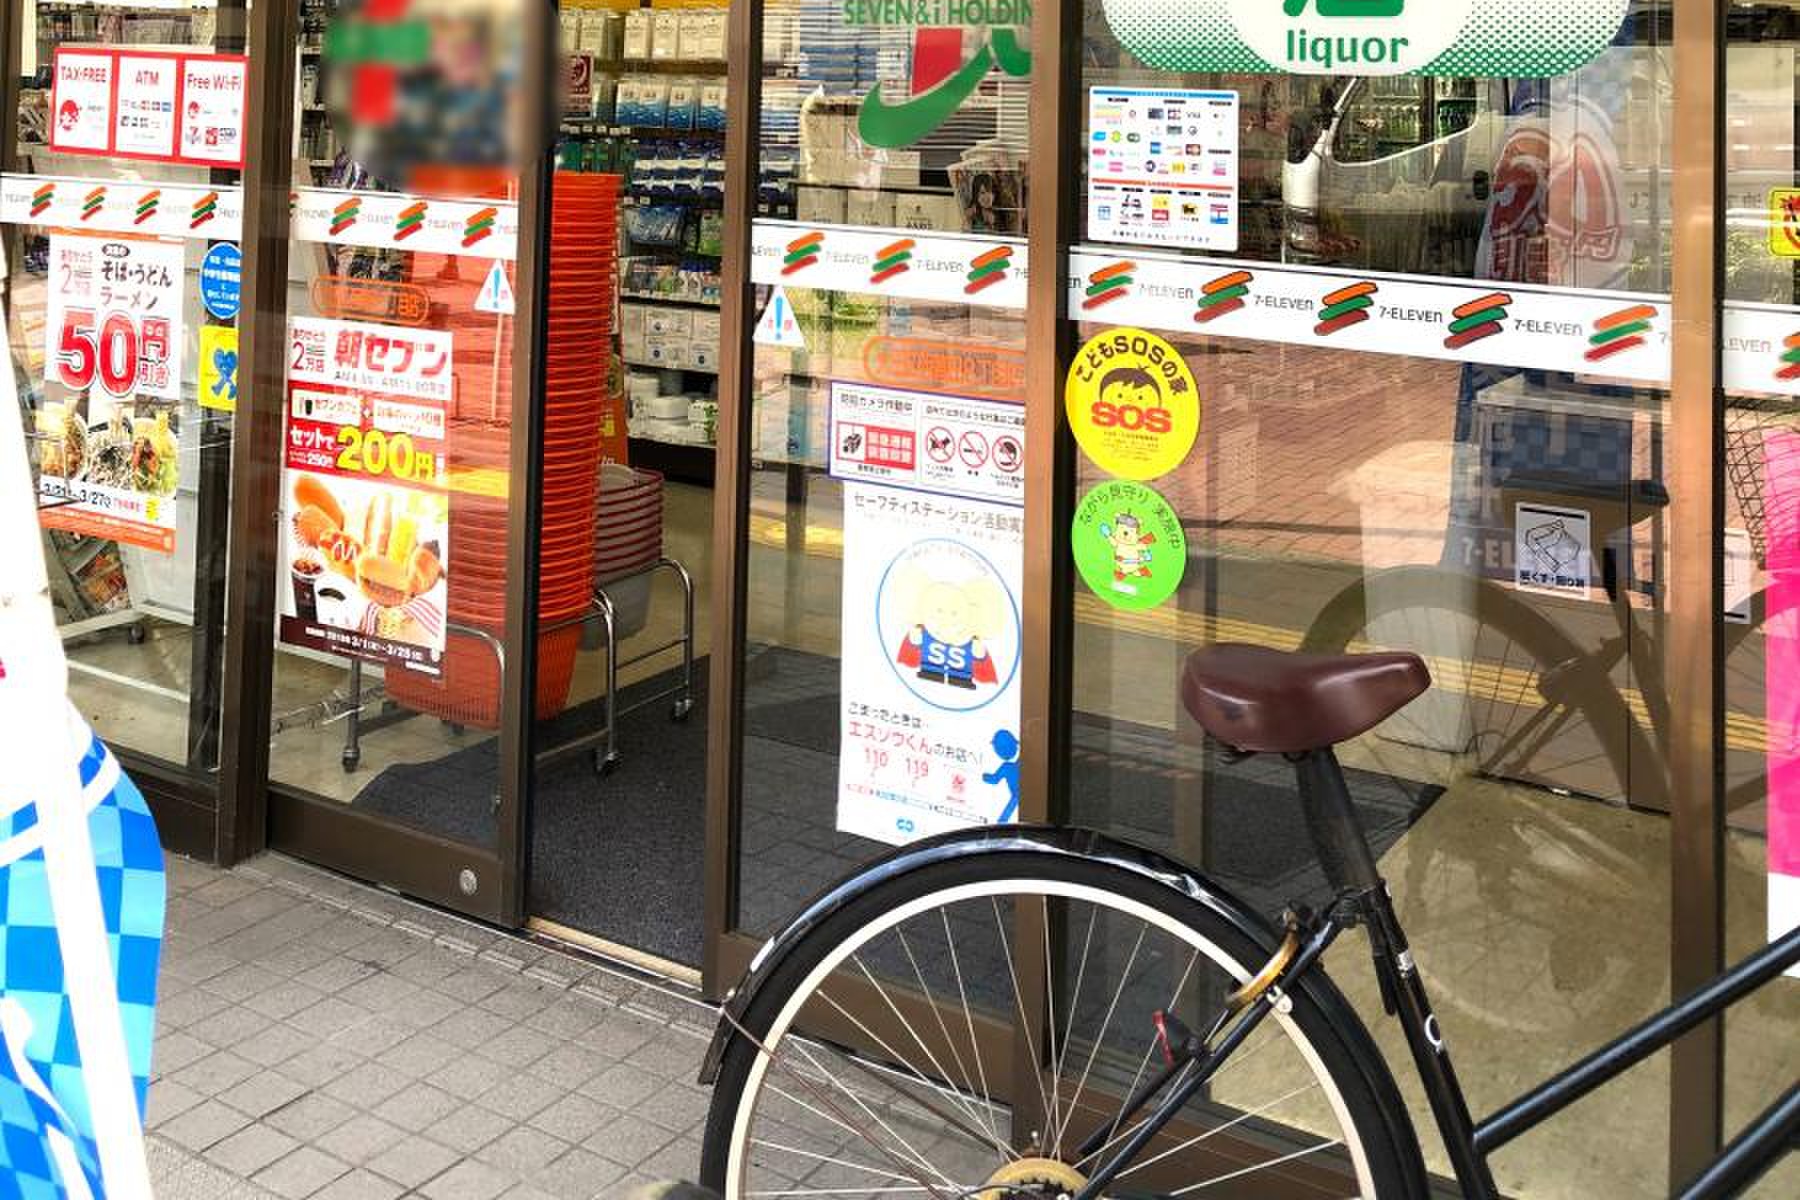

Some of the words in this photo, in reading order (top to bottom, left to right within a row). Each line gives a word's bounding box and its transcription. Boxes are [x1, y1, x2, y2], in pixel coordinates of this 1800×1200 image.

[1287, 30, 1409, 68] liquor
[135, 71, 160, 87] ATM
[101, 260, 173, 287] そば・うどん
[334, 329, 449, 378] 朝セブン
[1075, 335, 1189, 396] こどもSOSの家
[1090, 400, 1173, 434] SOS
[335, 425, 435, 482] 200円
[927, 642, 967, 670] SS
